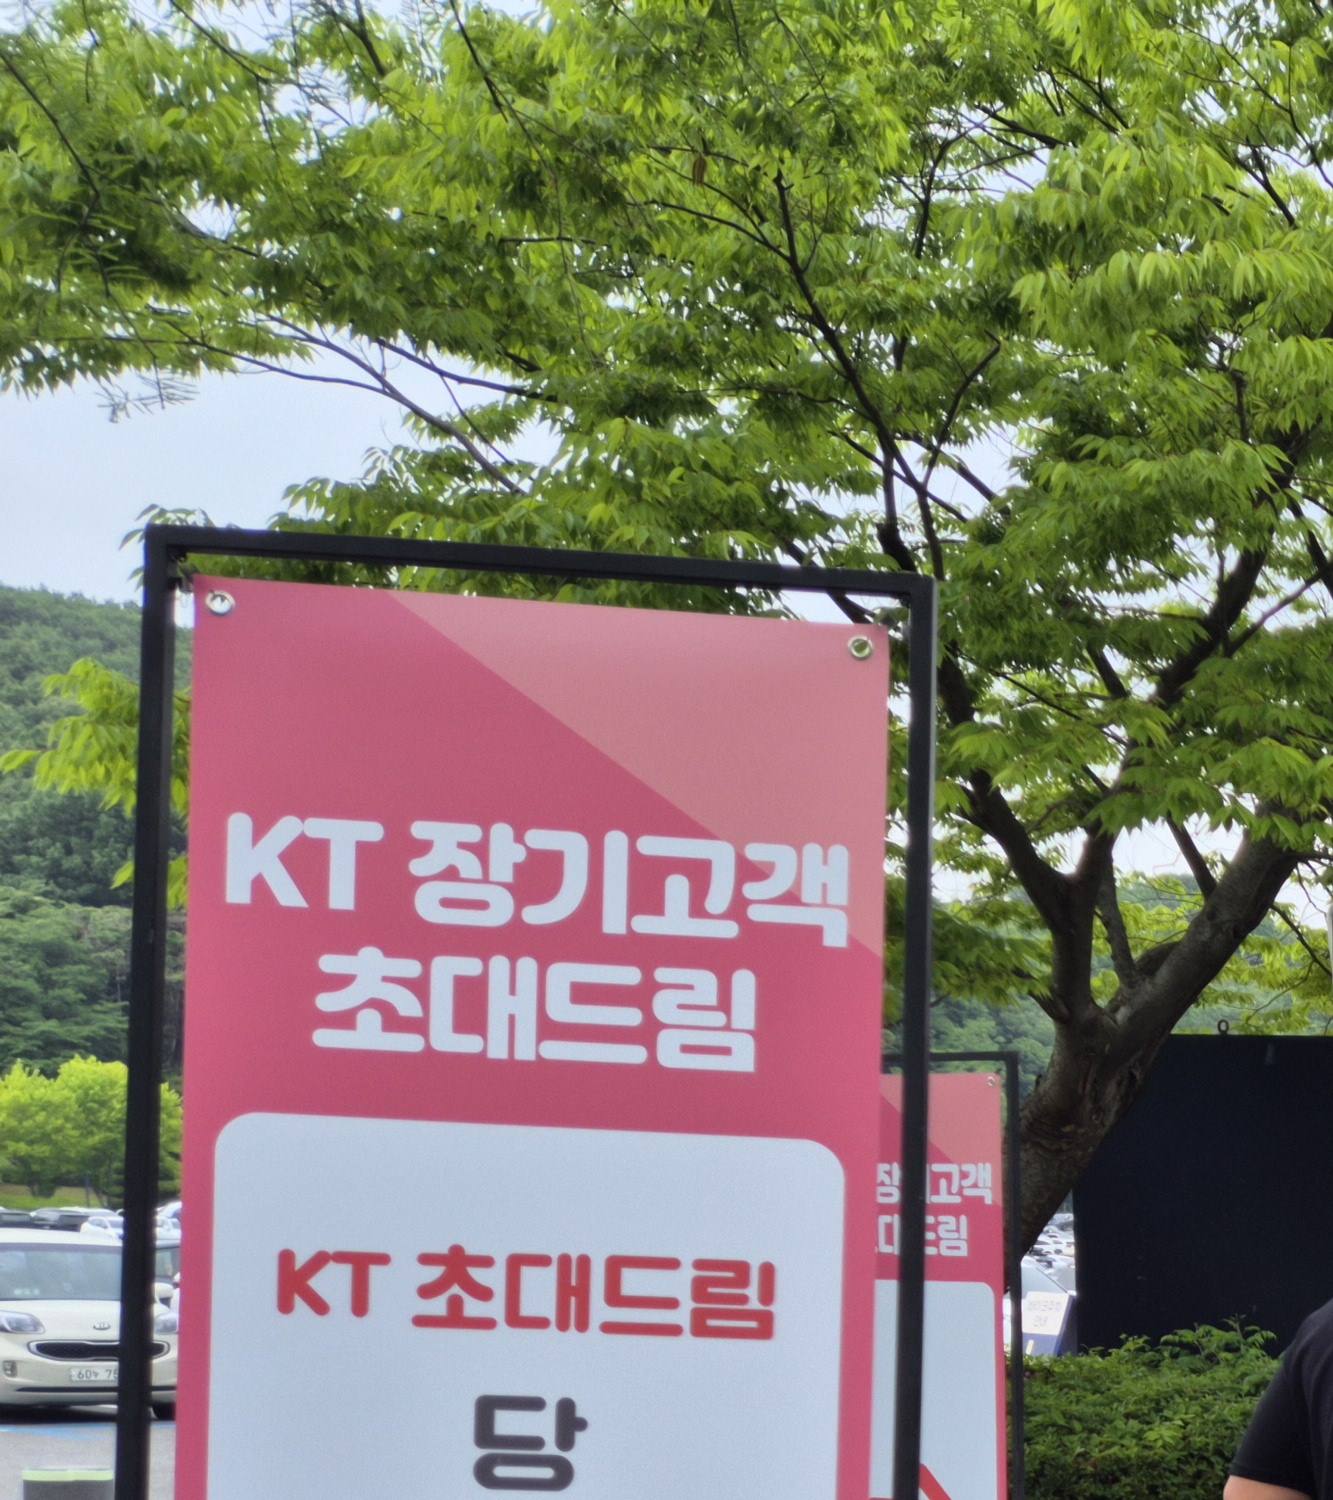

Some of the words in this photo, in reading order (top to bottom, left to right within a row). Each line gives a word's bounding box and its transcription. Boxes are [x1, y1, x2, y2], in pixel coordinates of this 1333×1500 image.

[226, 812, 384, 911] KT
[408, 820, 850, 949] 장기고객
[312, 946, 757, 1073] 초대드림
[876, 1161, 993, 1205] 장고객
[276, 1247, 391, 1318] KT
[411, 1243, 776, 1341] 초대드림
